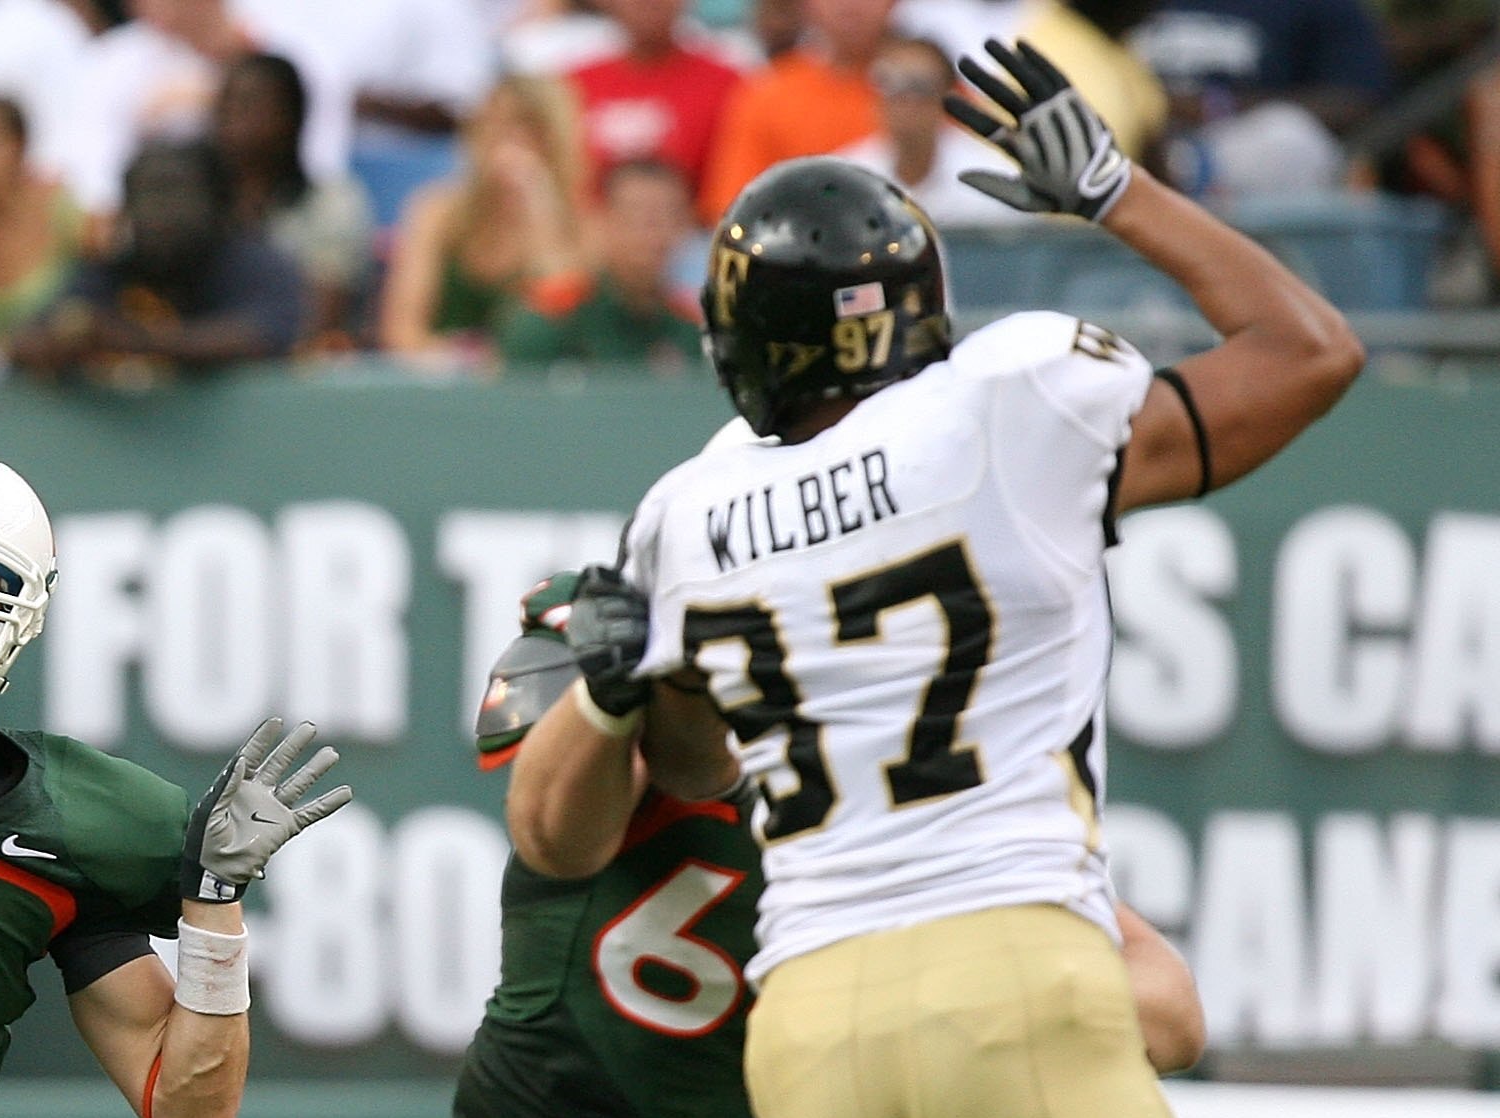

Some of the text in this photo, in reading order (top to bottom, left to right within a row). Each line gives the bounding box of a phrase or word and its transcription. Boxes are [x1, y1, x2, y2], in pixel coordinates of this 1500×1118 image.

[833, 309, 896, 374] 97
[706, 449, 898, 573] WILBER
[46, 503, 412, 752] FOR
[678, 532, 998, 850] 97
